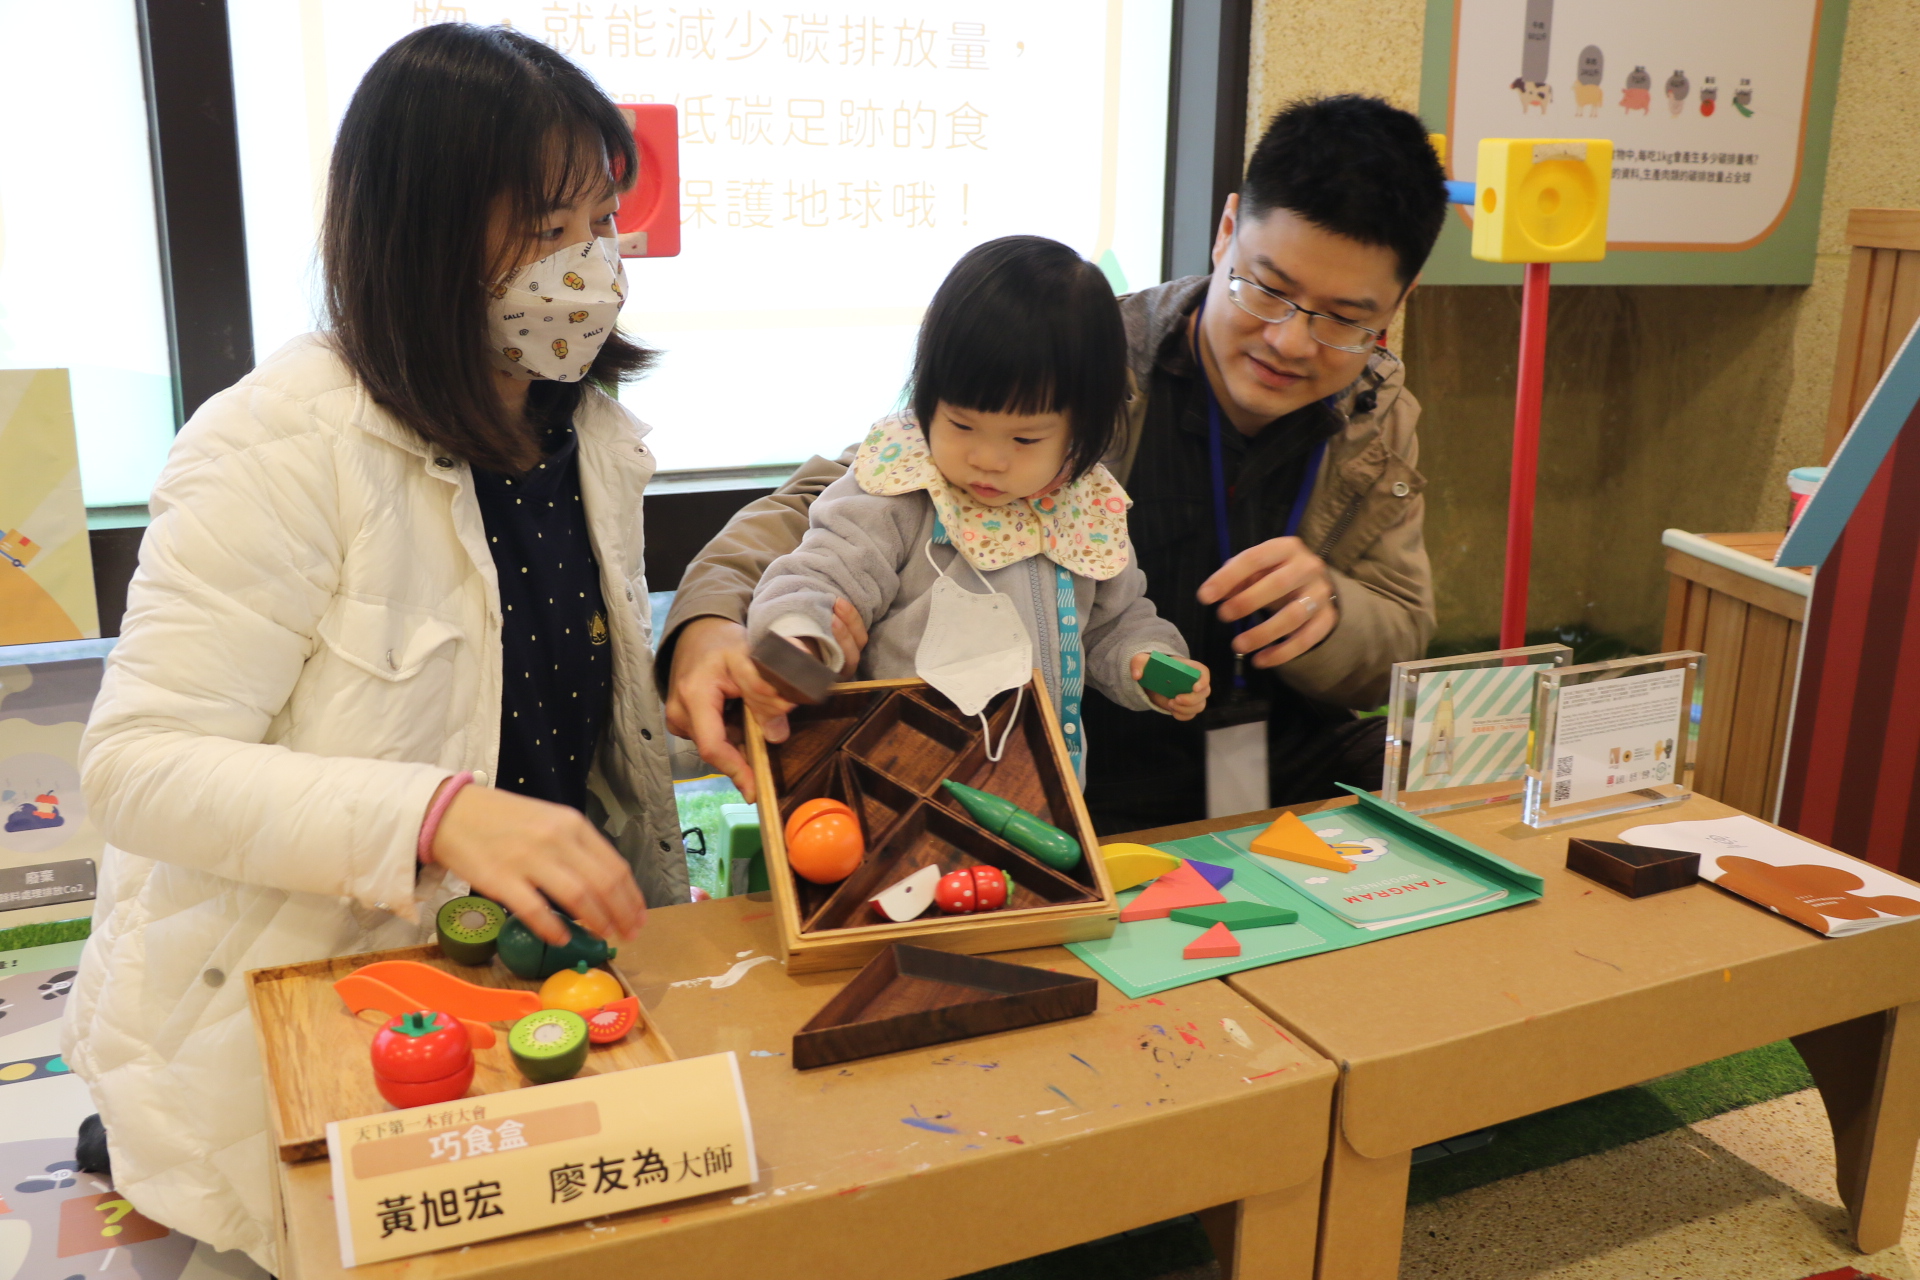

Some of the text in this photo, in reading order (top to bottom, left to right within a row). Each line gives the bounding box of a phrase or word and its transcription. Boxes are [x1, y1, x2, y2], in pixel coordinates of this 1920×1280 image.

[611, 93, 990, 150] 低碳足跡的食
[581, 241, 594, 258] SALL
[503, 311, 525, 321] SALLY
[583, 327, 604, 339] SALLY
[1342, 873, 1421, 893] WOODINESS
[1342, 878, 1448, 905] TANGRAM
[354, 1104, 487, 1143] 天下第一木育大會
[428, 1119, 529, 1163] 巧食盒
[376, 1179, 504, 1239] 黃旭宏
